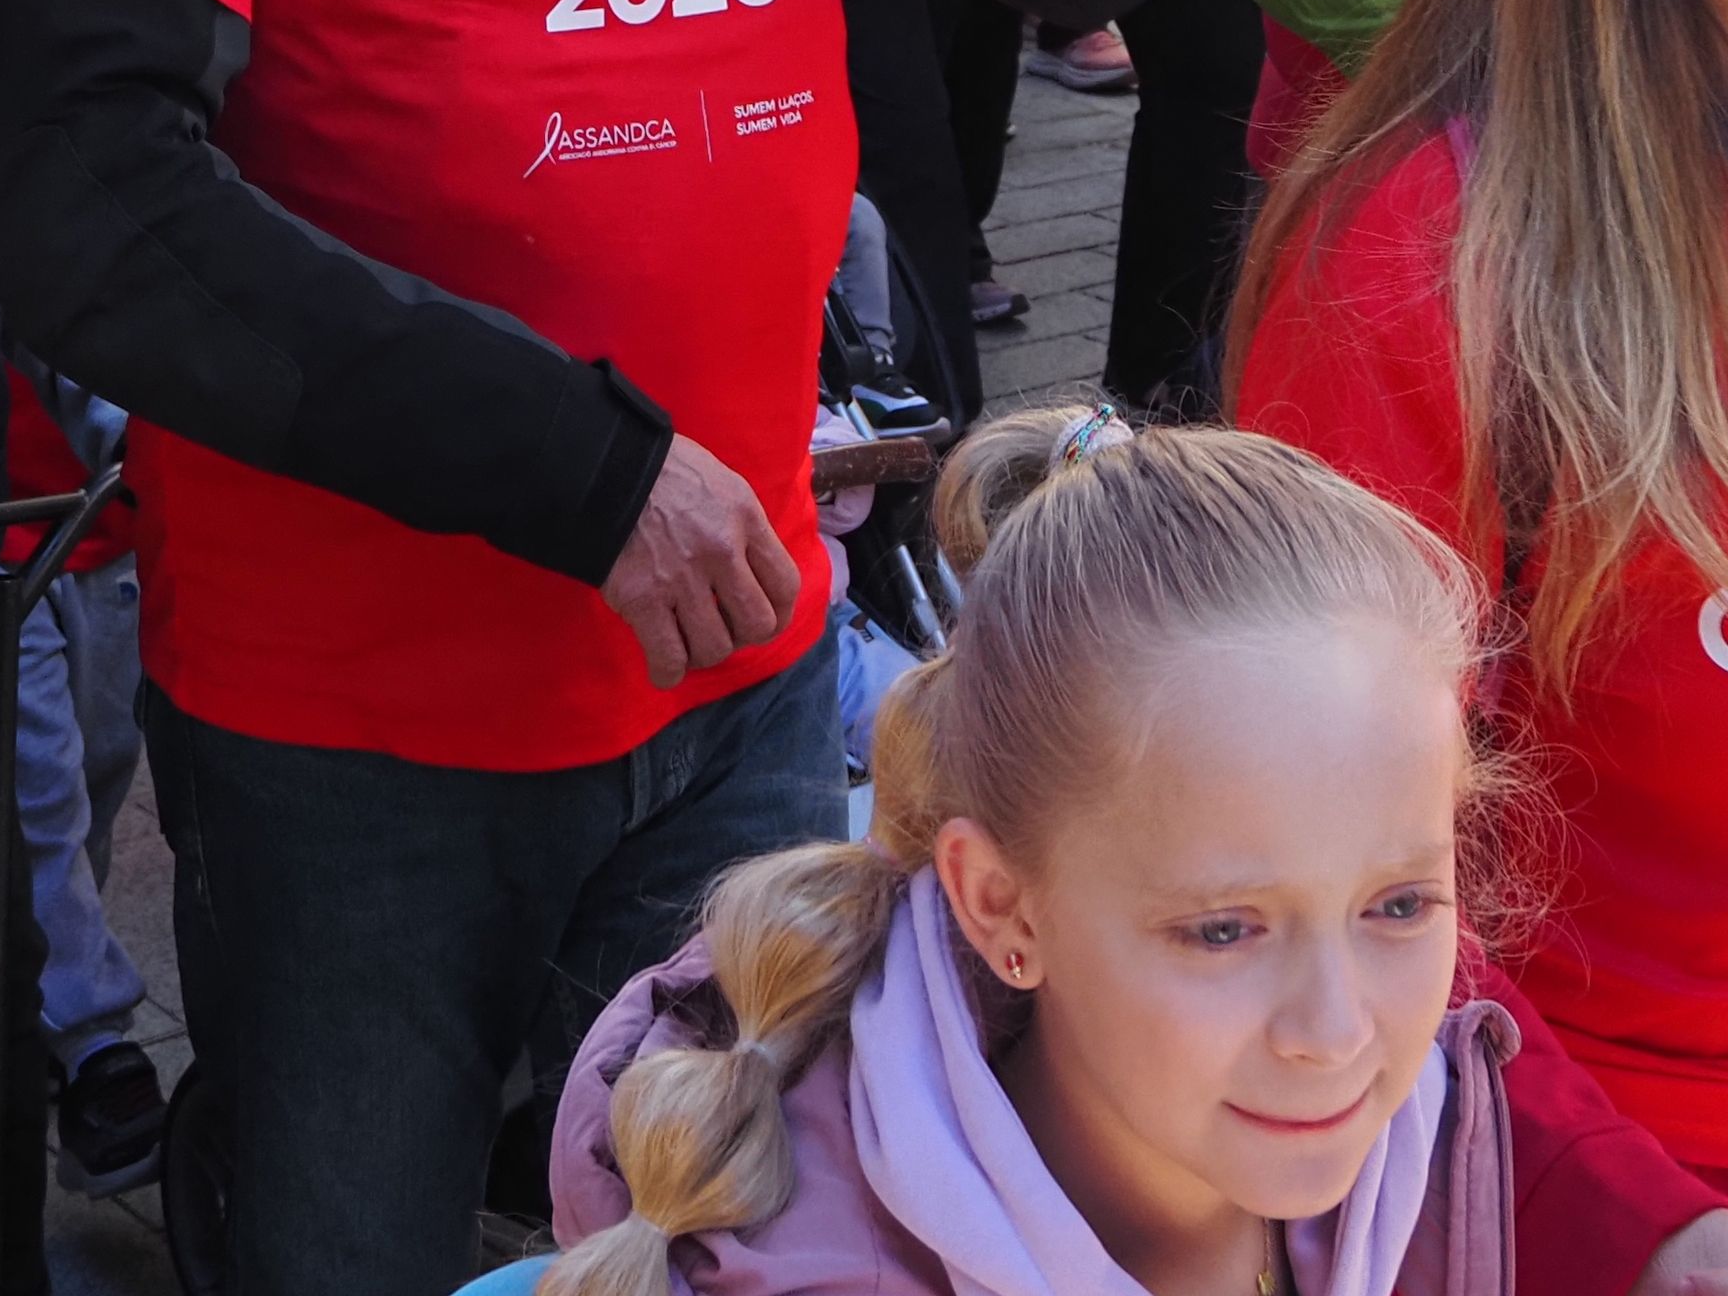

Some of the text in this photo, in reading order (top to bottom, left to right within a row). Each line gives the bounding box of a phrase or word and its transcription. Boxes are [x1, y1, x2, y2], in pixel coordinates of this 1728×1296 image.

[734, 99, 776, 119] SUMEM
[558, 118, 676, 150] ASSANDCA
[736, 110, 802, 136] SUMEM VIDA
